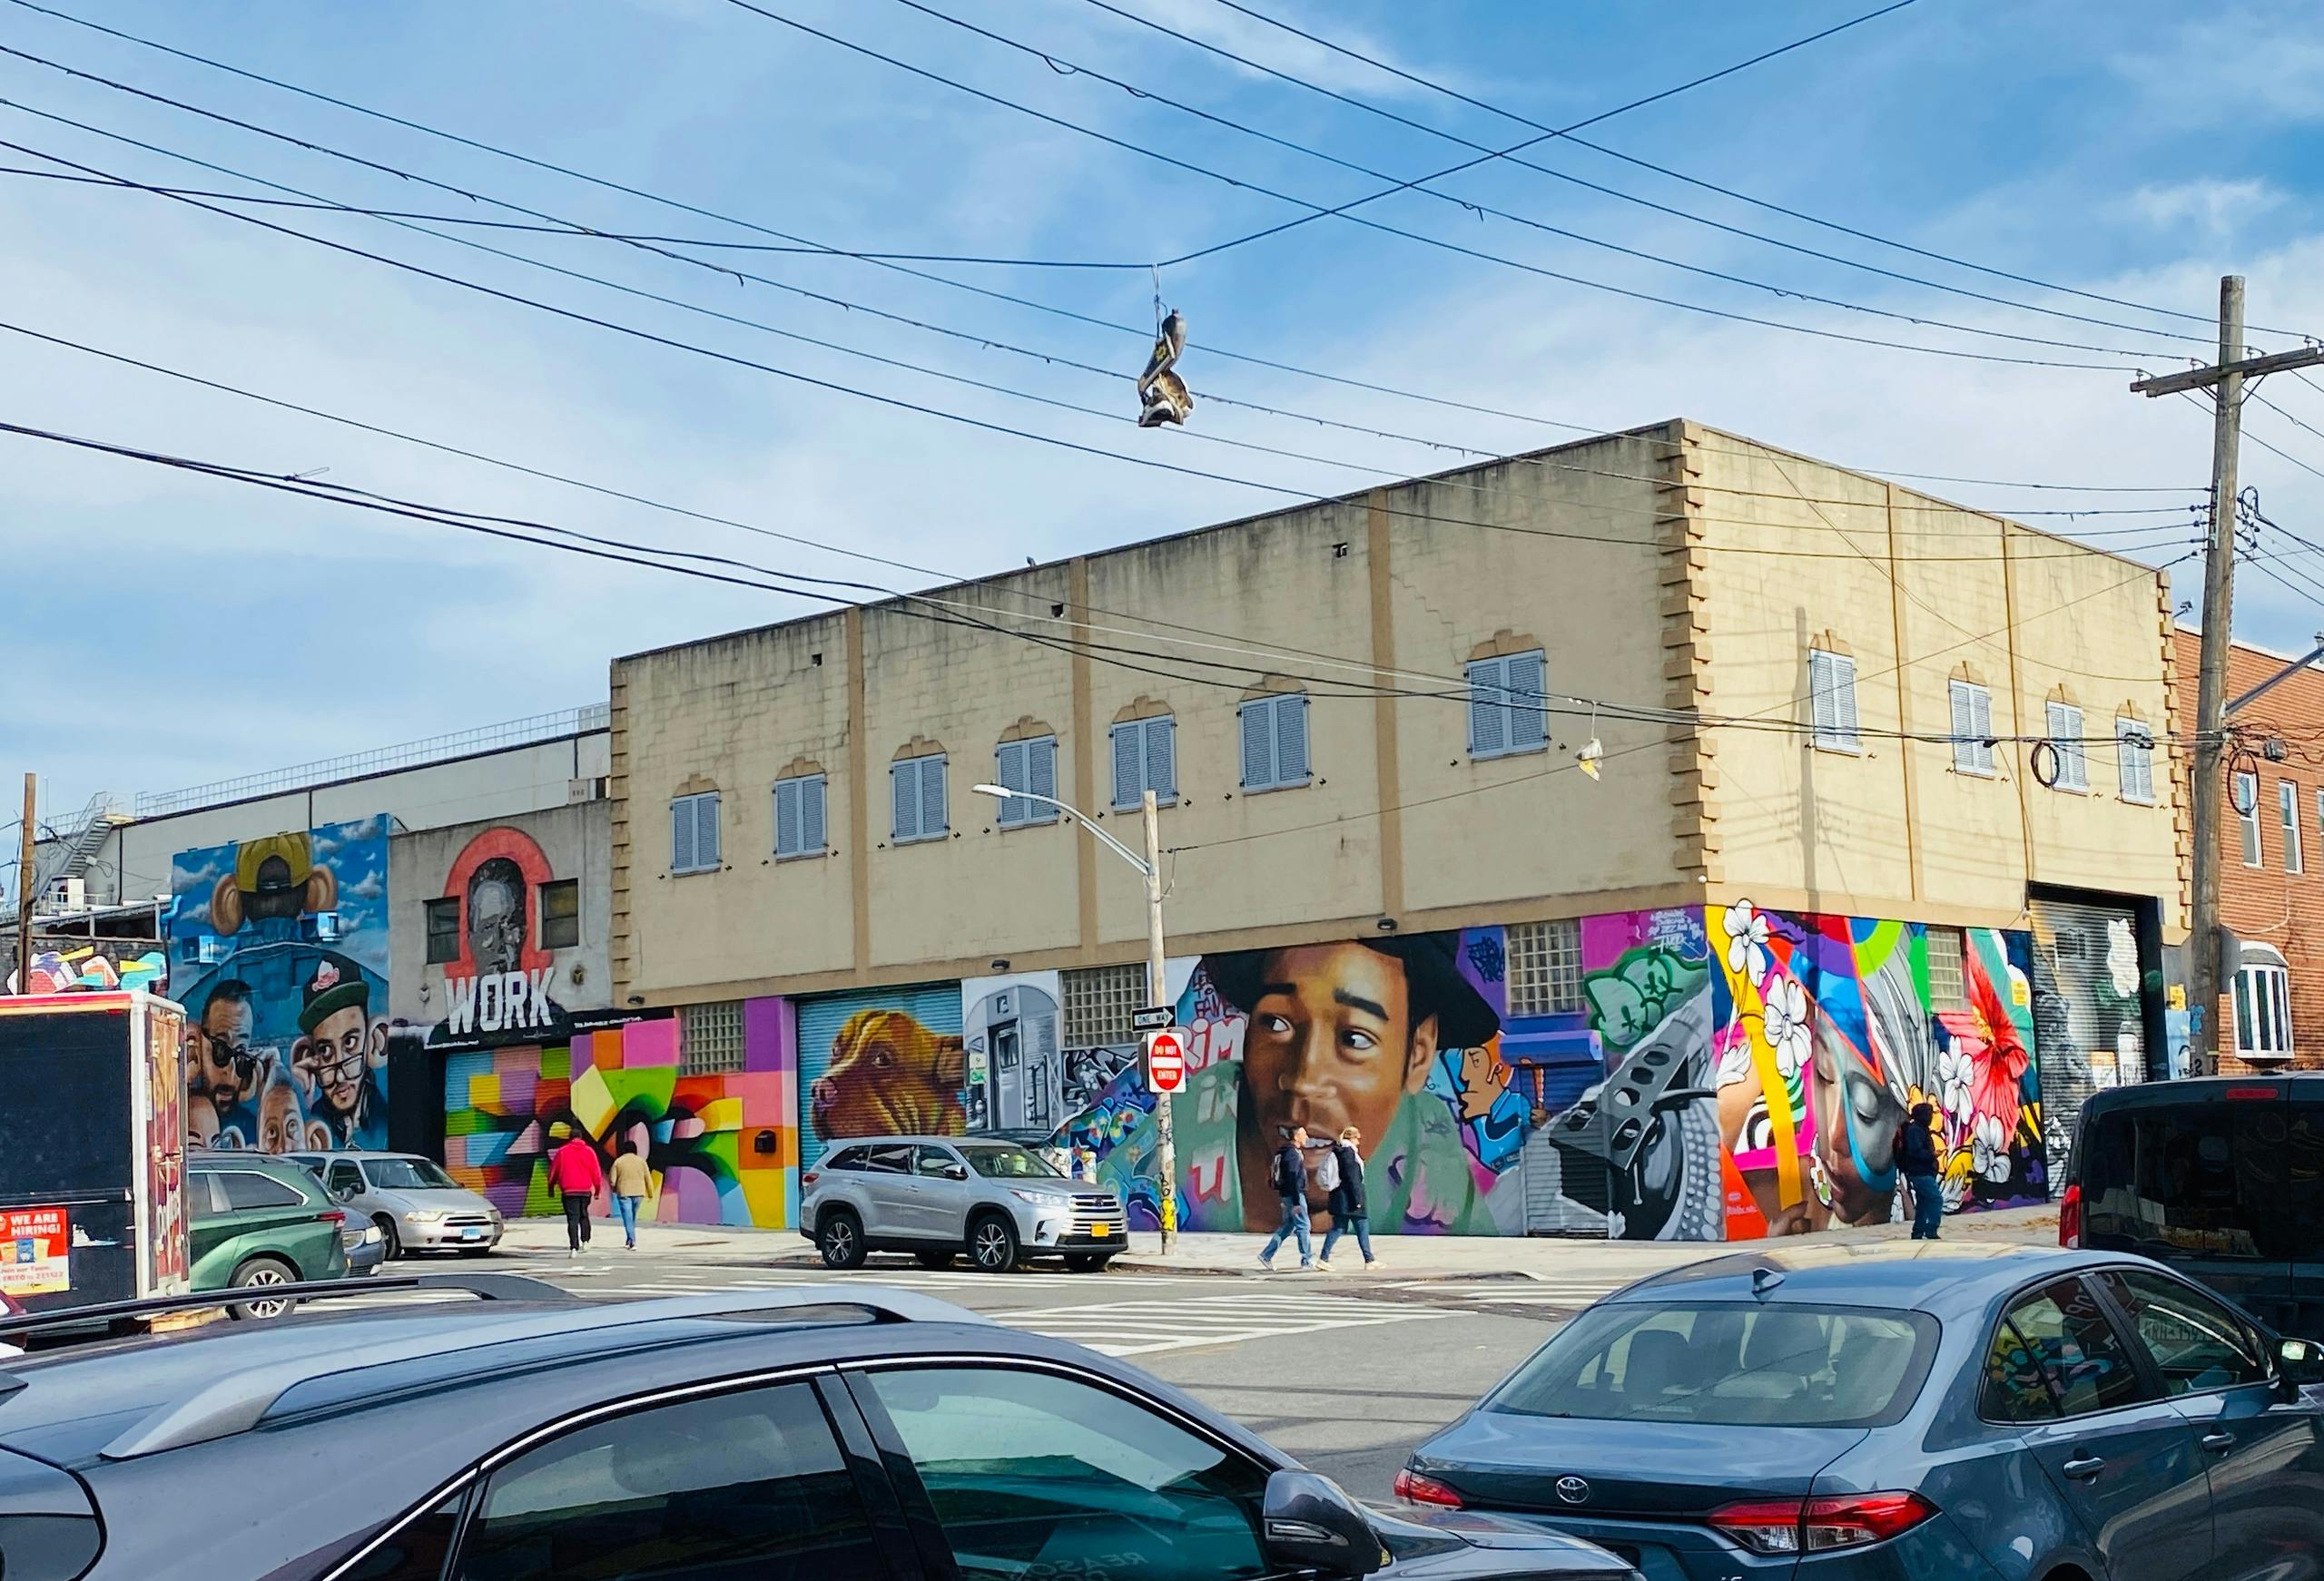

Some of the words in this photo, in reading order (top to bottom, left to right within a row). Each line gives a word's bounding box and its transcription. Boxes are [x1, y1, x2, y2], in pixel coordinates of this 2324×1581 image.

[445, 967, 554, 1035] WORK
[1137, 1015, 1151, 1024] ONE
[1156, 1013, 1169, 1022] WAY
[1154, 1045, 1165, 1055] DO
[1165, 1045, 1177, 1055] NOT
[1157, 1070, 1177, 1080] ENTER
[10, 1214, 31, 1225] WE
[34, 1213, 58, 1223] ARE
[11, 1223, 61, 1235] HIRING!
